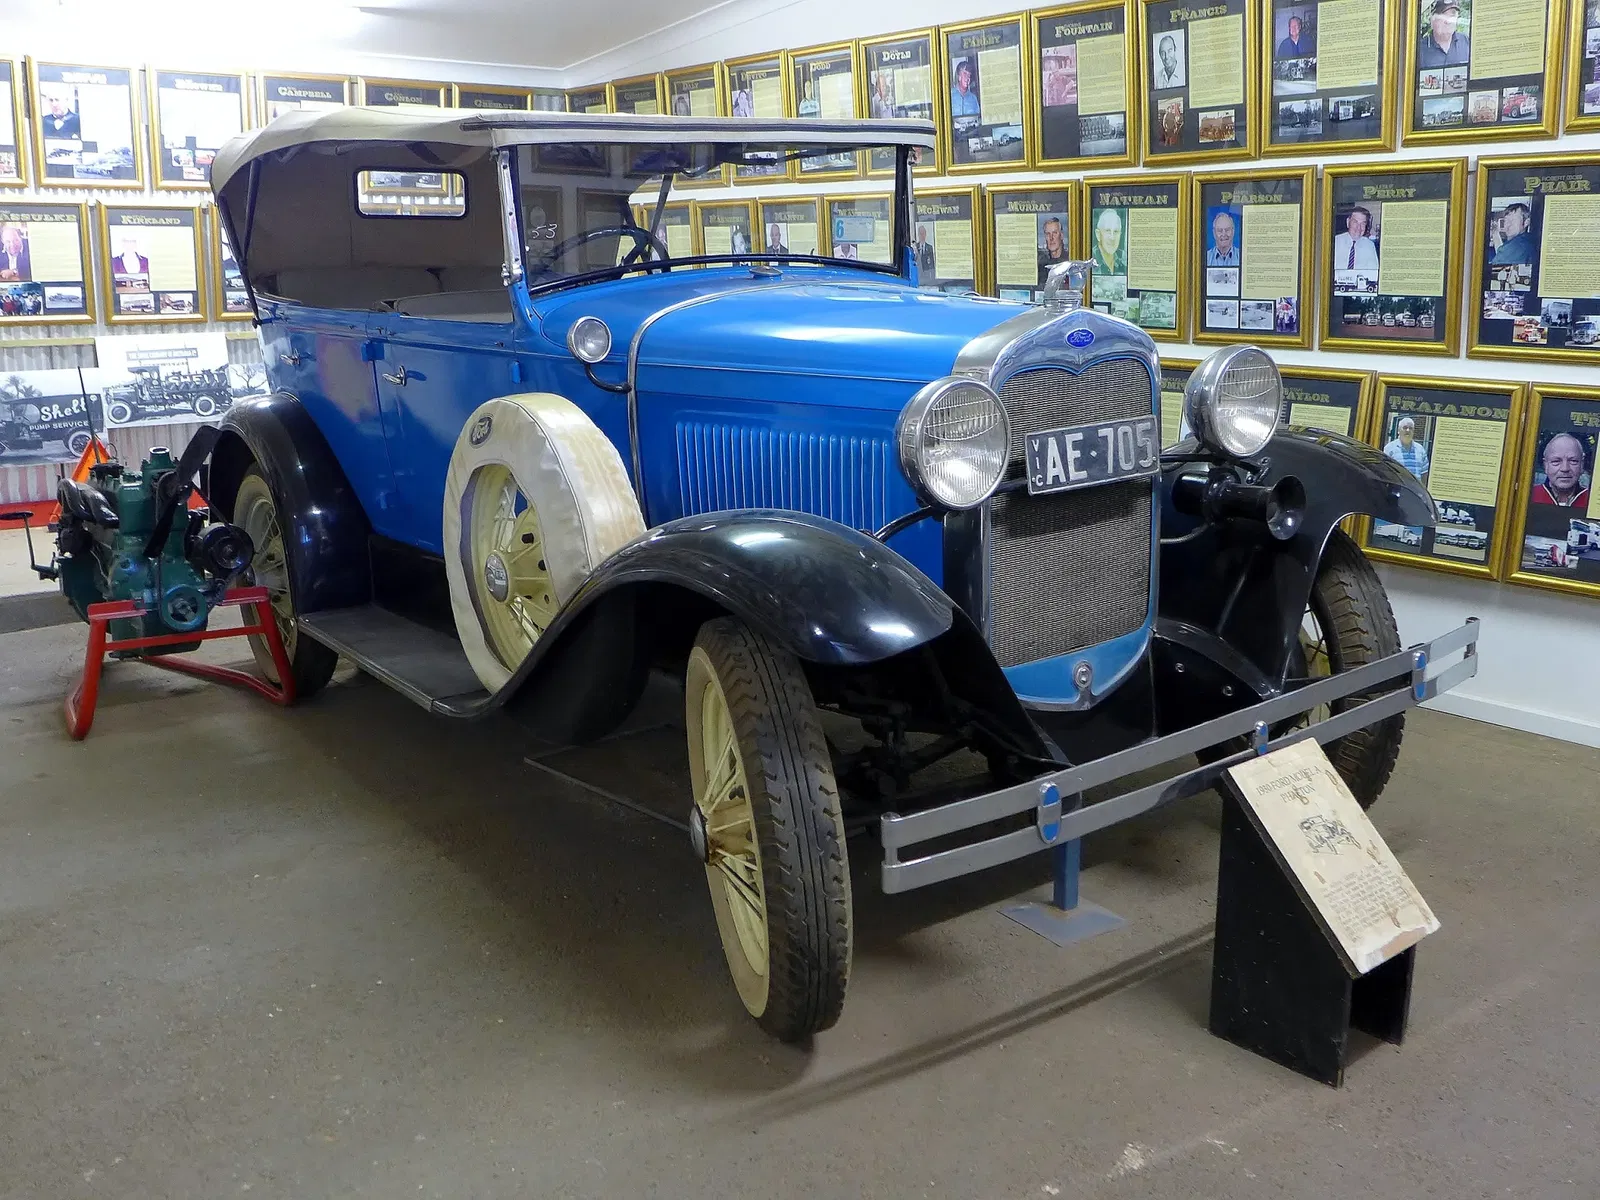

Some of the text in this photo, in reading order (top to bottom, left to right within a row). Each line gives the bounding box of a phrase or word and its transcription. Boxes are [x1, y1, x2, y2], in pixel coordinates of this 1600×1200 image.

[1169, 4, 1228, 23] FRANCIS
[1055, 22, 1113, 38] FOUNTAIN
[882, 50, 911, 61] DOYLE
[278, 86, 333, 99] CAMPBELL
[384, 92, 423, 103] CONLON
[1523, 176, 1591, 194] PHAIR
[1099, 192, 1169, 206] NATHAN
[1220, 191, 1284, 204] PEARSON
[1362, 186, 1417, 199] PERRY
[1007, 201, 1053, 212] MURRAY
[1069, 331, 1092, 345] Ford
[41, 397, 87, 422] Shell
[1388, 395, 1509, 420] TRAIANON
[53, 420, 89, 429] SERVICE
[1270, 776, 1291, 790] FORD
